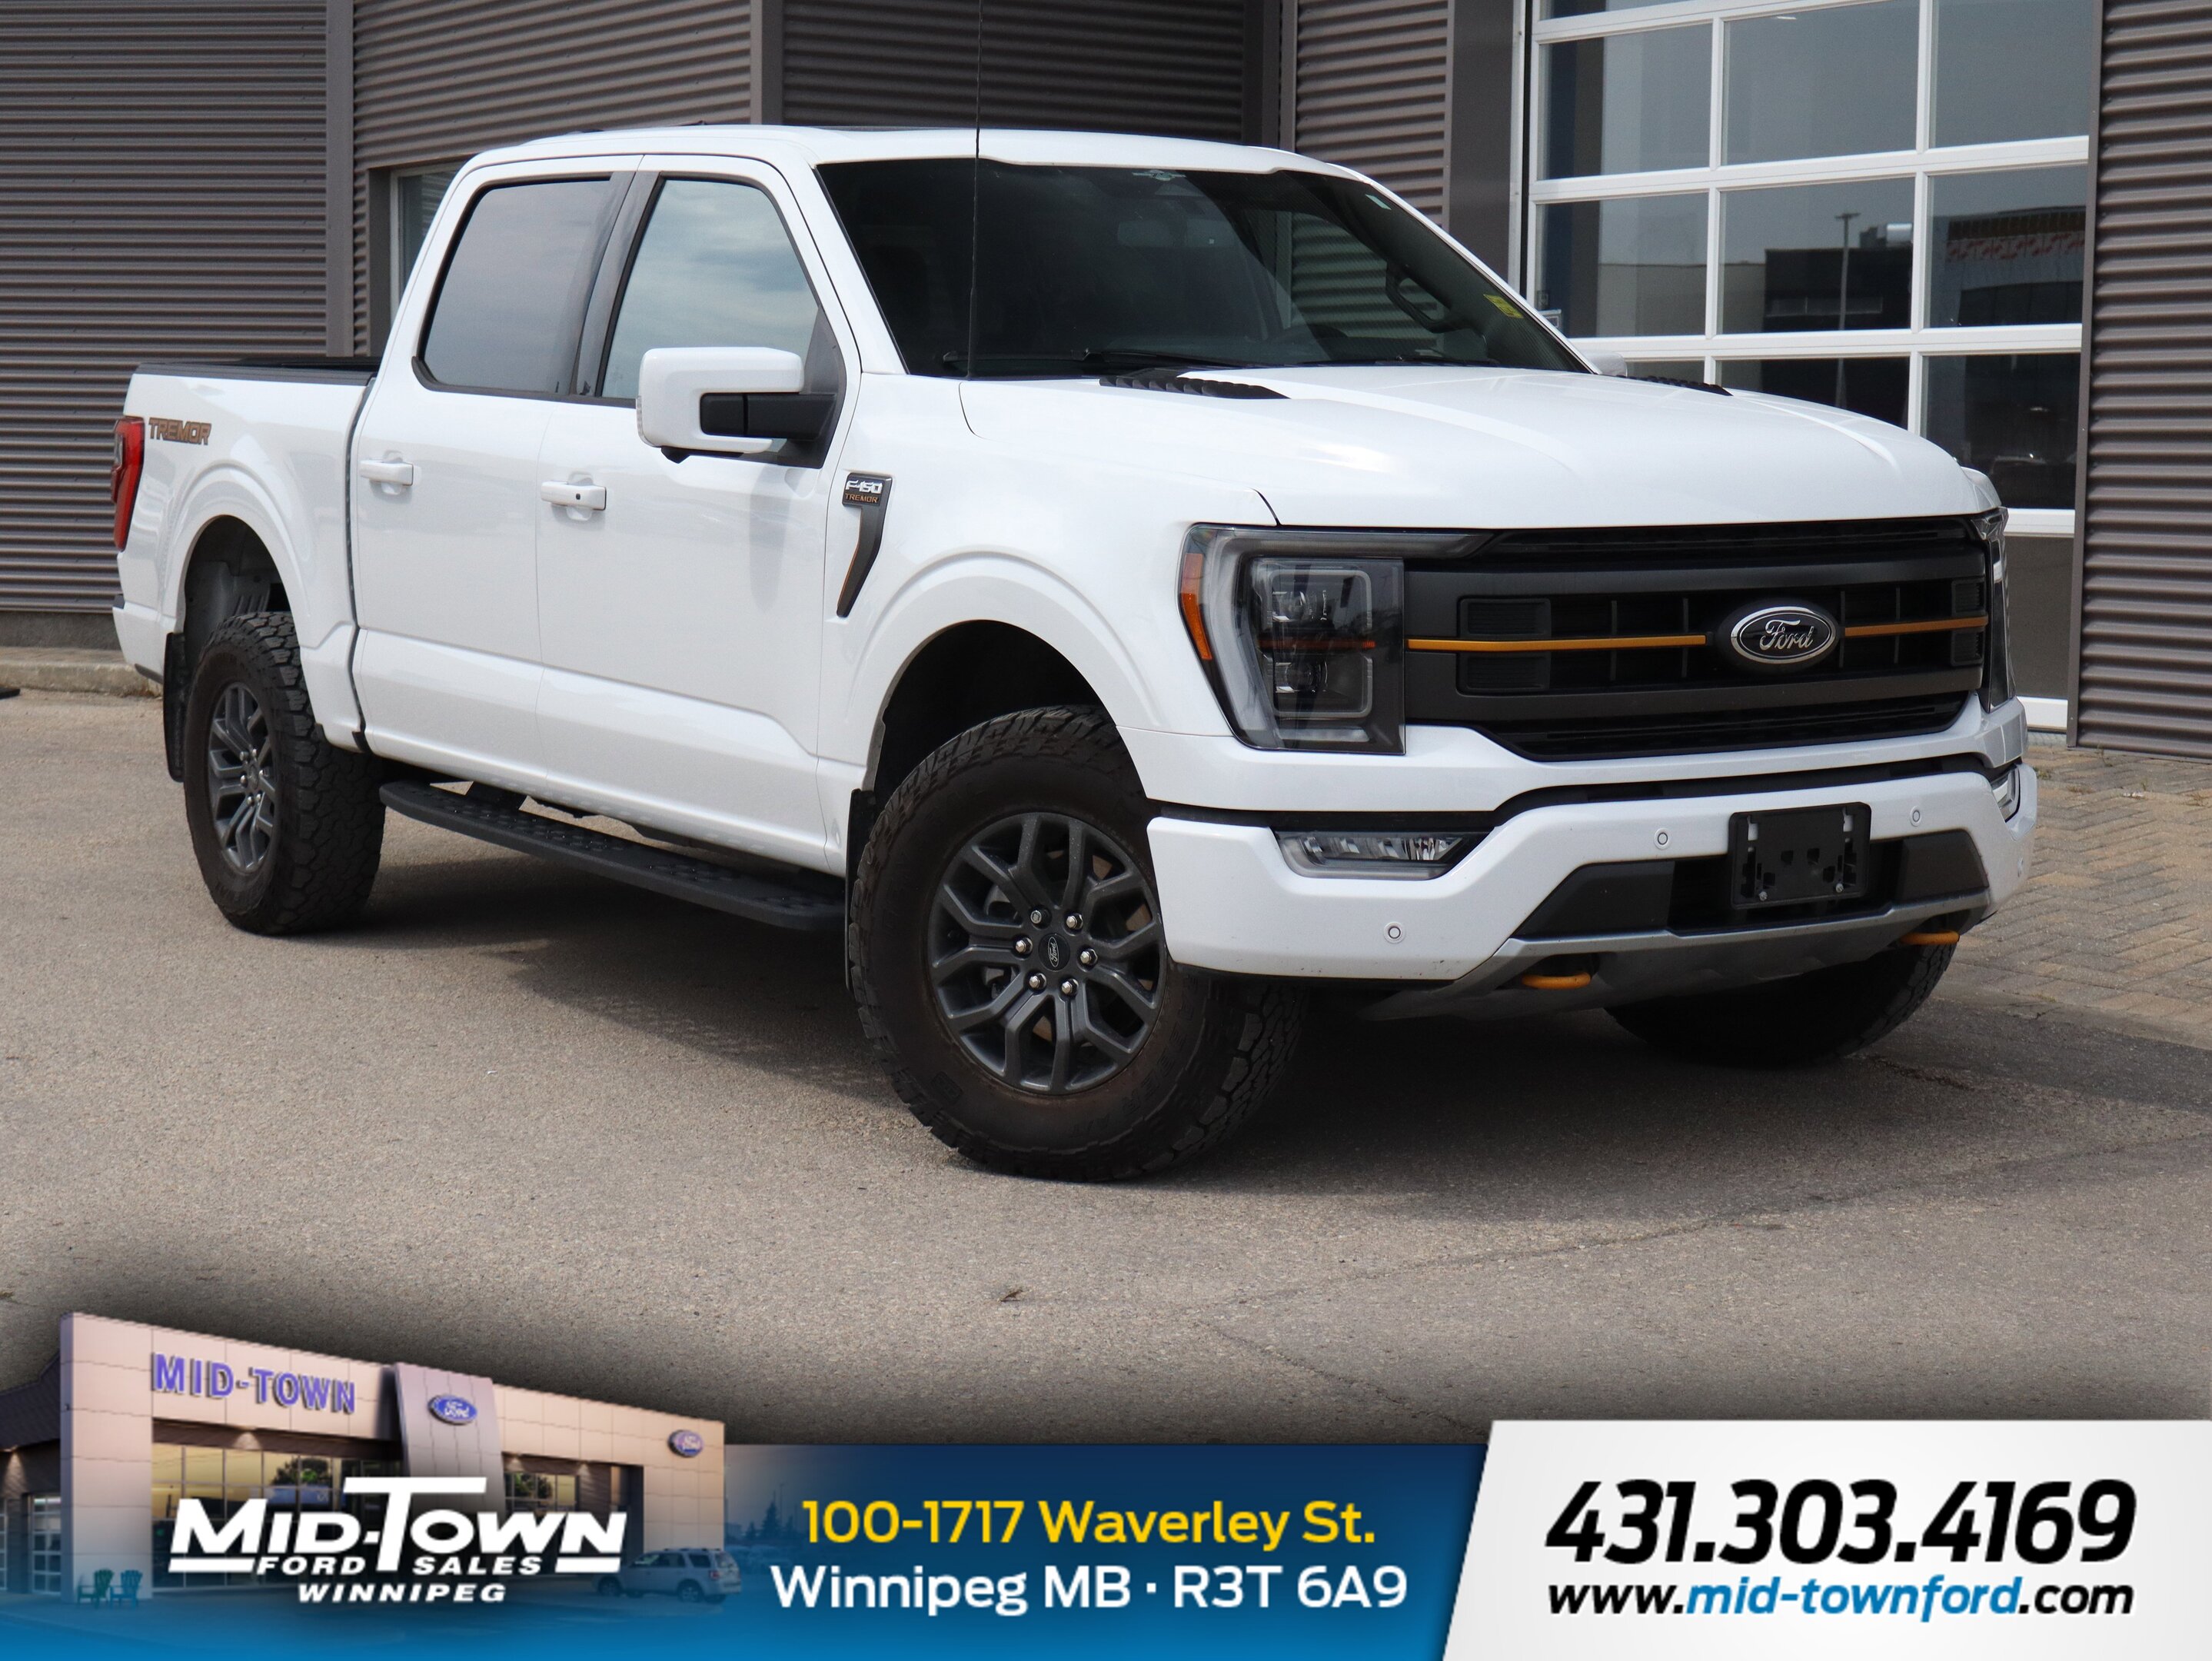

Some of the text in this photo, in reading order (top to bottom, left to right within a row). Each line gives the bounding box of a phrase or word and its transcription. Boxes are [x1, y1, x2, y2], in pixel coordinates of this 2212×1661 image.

[148, 417, 211, 445] TREMOR
[845, 479, 883, 494] F-150
[845, 493, 878, 503] TREMOR
[1759, 619, 1815, 651] Ford
